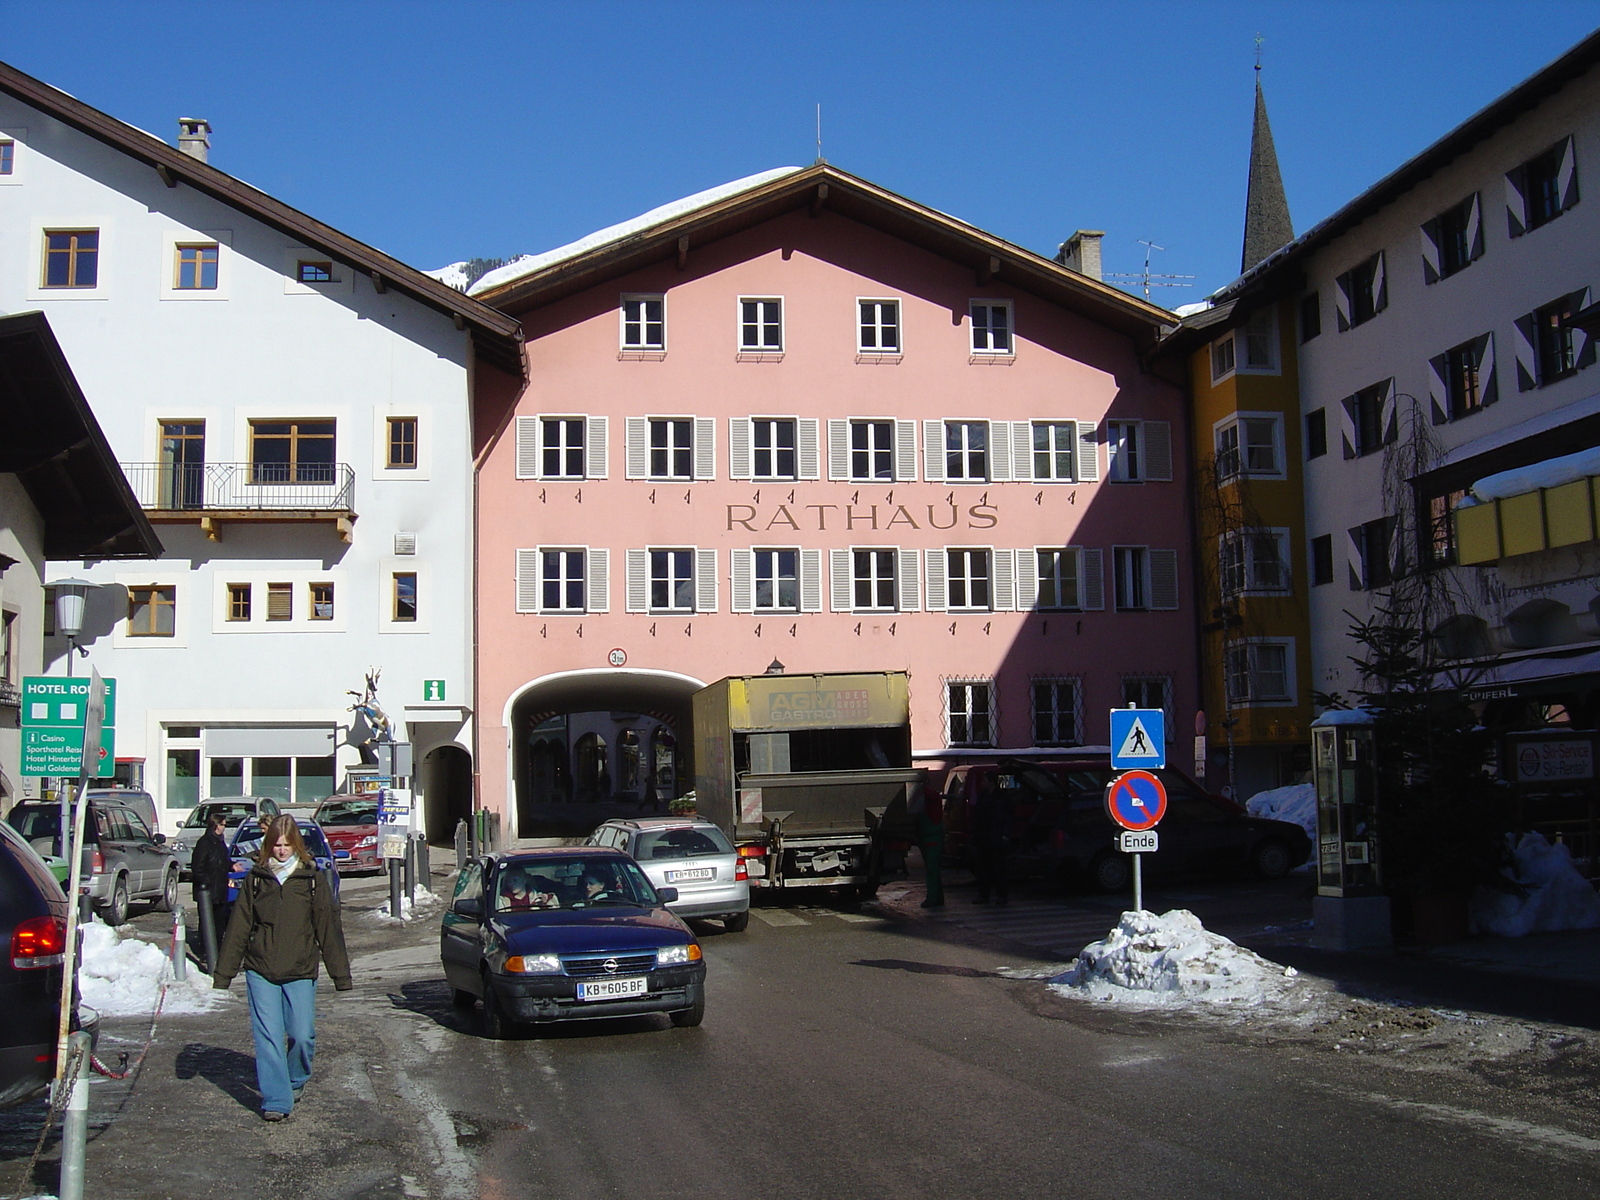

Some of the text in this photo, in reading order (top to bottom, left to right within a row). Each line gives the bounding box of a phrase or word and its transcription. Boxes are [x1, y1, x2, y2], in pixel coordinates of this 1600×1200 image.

[726, 504, 998, 532] RATHAUS
[27, 684, 111, 695] HOTEL ROE
[837, 690, 867, 699] ADEG
[771, 692, 836, 710] AGM
[770, 709, 836, 720] GASTRO
[40, 734, 66, 742] Casino
[26, 745, 64, 754] Sporthotel
[1542, 743, 1588, 759] Ski-Service
[47, 764, 80, 772] Goldener
[1124, 835, 1155, 847] Ende
[586, 980, 643, 996] KB 605 BF
